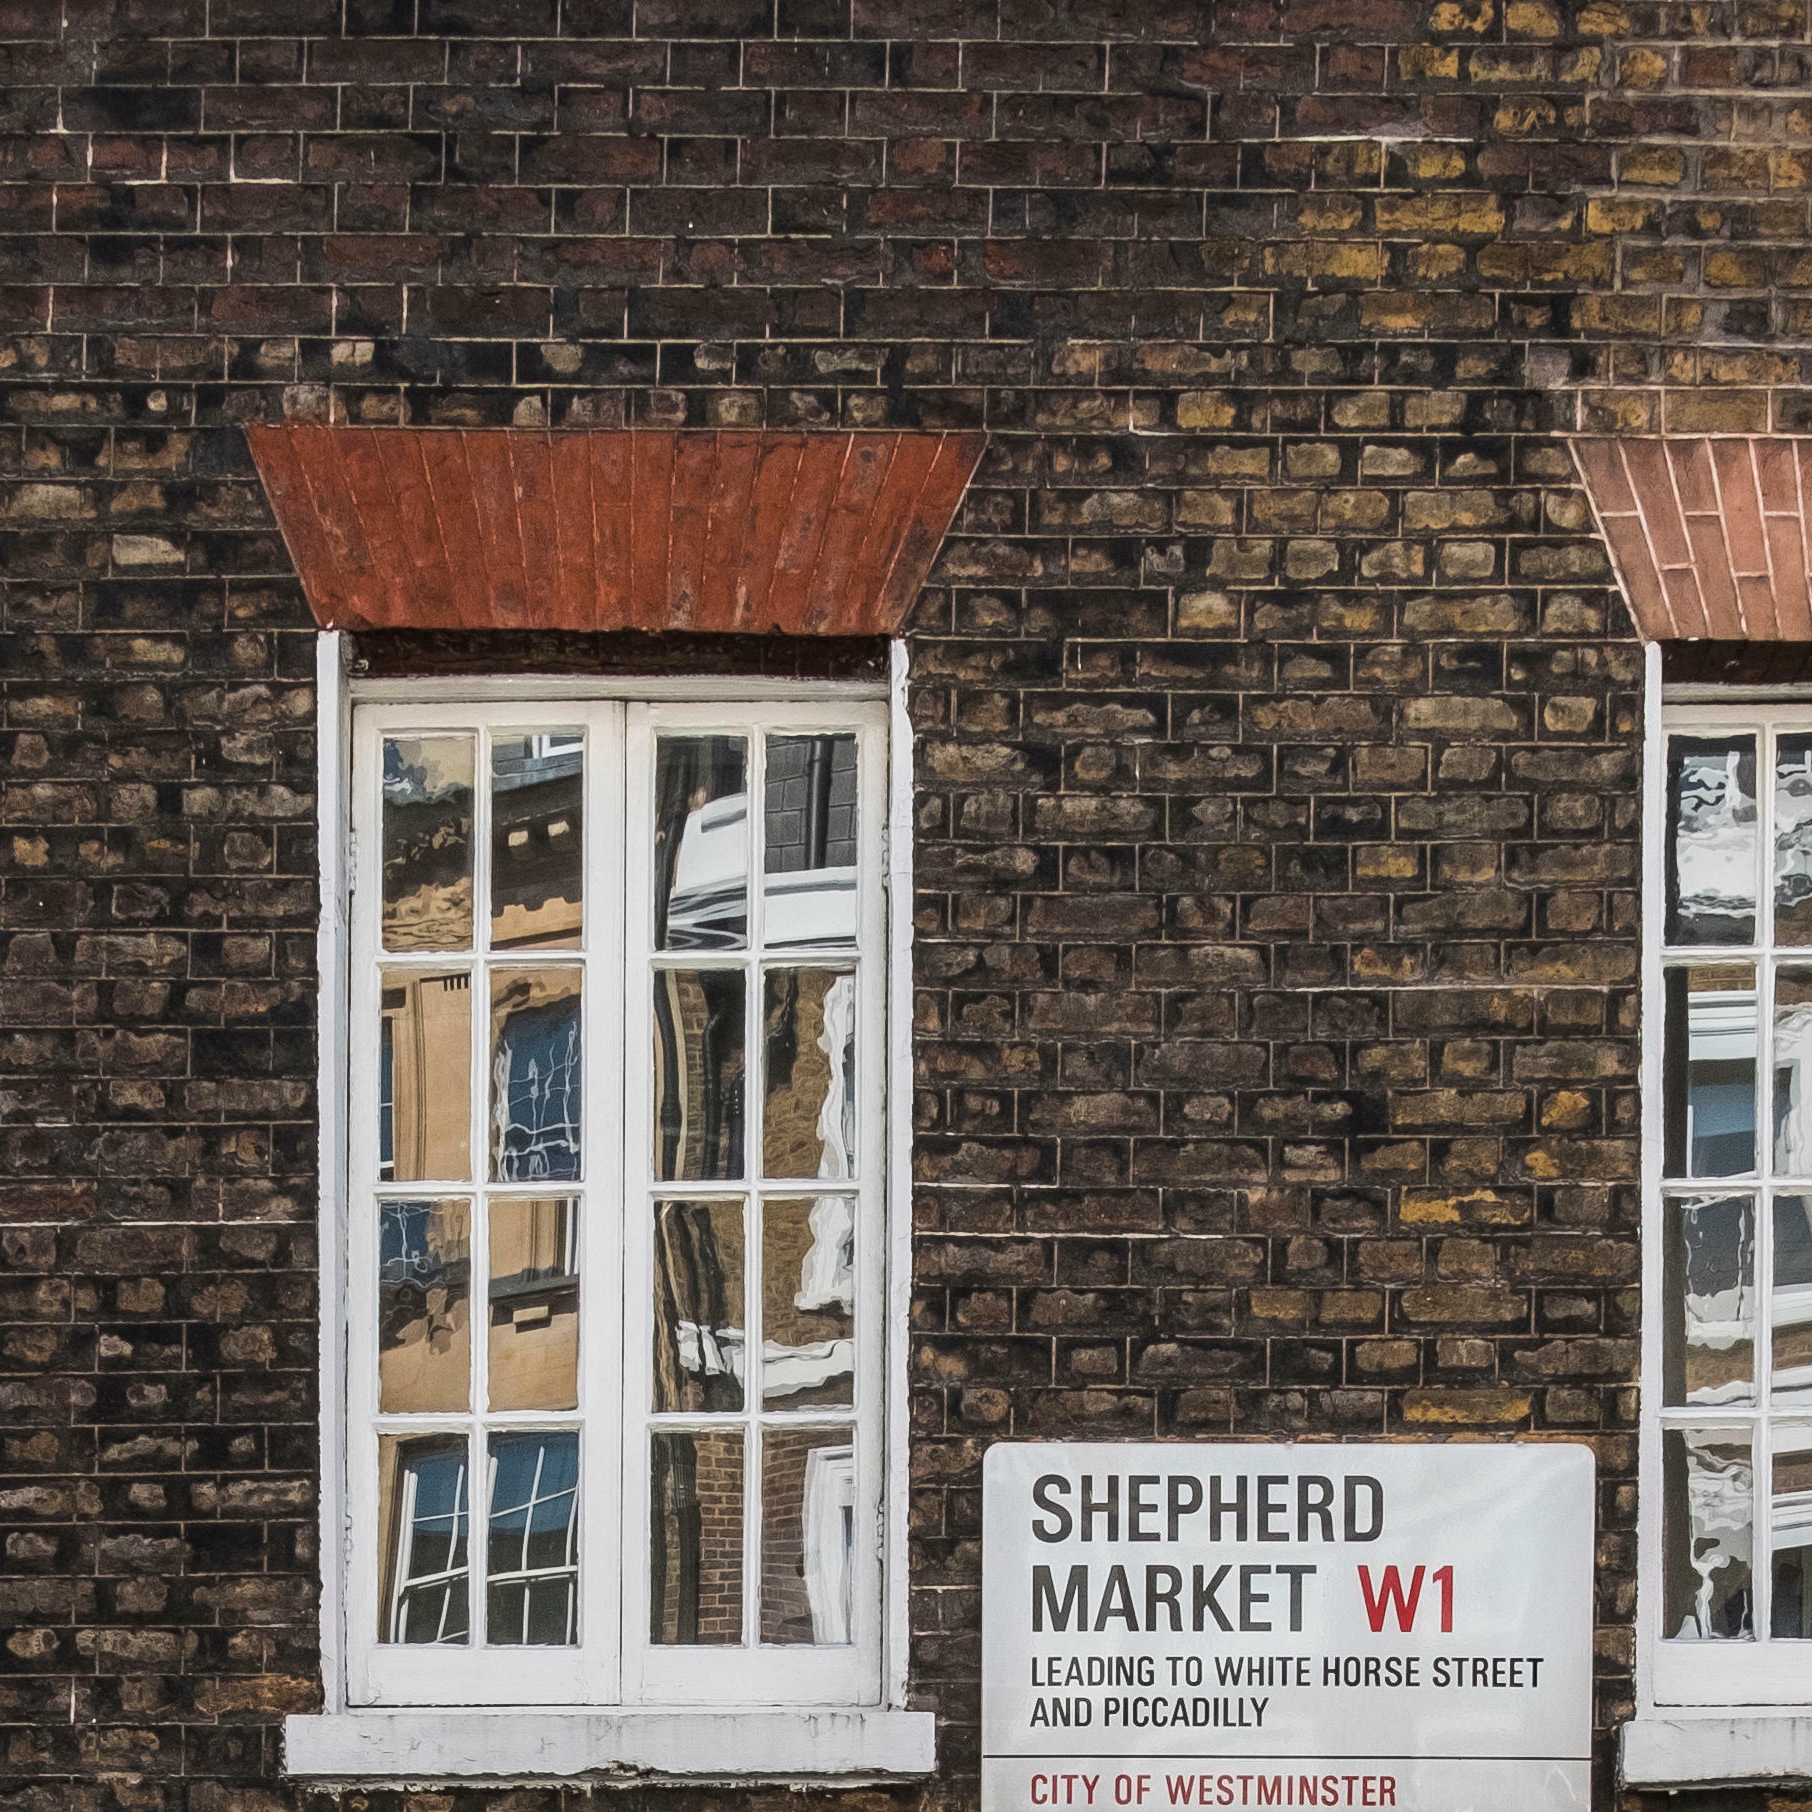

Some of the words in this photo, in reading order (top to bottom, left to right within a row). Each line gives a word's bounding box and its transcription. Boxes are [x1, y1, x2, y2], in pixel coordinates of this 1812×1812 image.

[1030, 1474, 1384, 1544] SHEPHERD
[1030, 1564, 1317, 1633] MARKET
[1357, 1564, 1454, 1633] W1
[1030, 1656, 1155, 1687] LEADING
[1166, 1656, 1203, 1687] TO
[1214, 1657, 1311, 1687] WHITE
[1322, 1657, 1421, 1687] HORSE
[1432, 1657, 1544, 1688] STREET
[1029, 1697, 1093, 1727] AND
[1104, 1697, 1269, 1728] PICCADILLY
[1030, 1774, 1099, 1806] CITY
[1113, 1774, 1151, 1806] OF
[1165, 1774, 1397, 1807] WESTMINSTER
